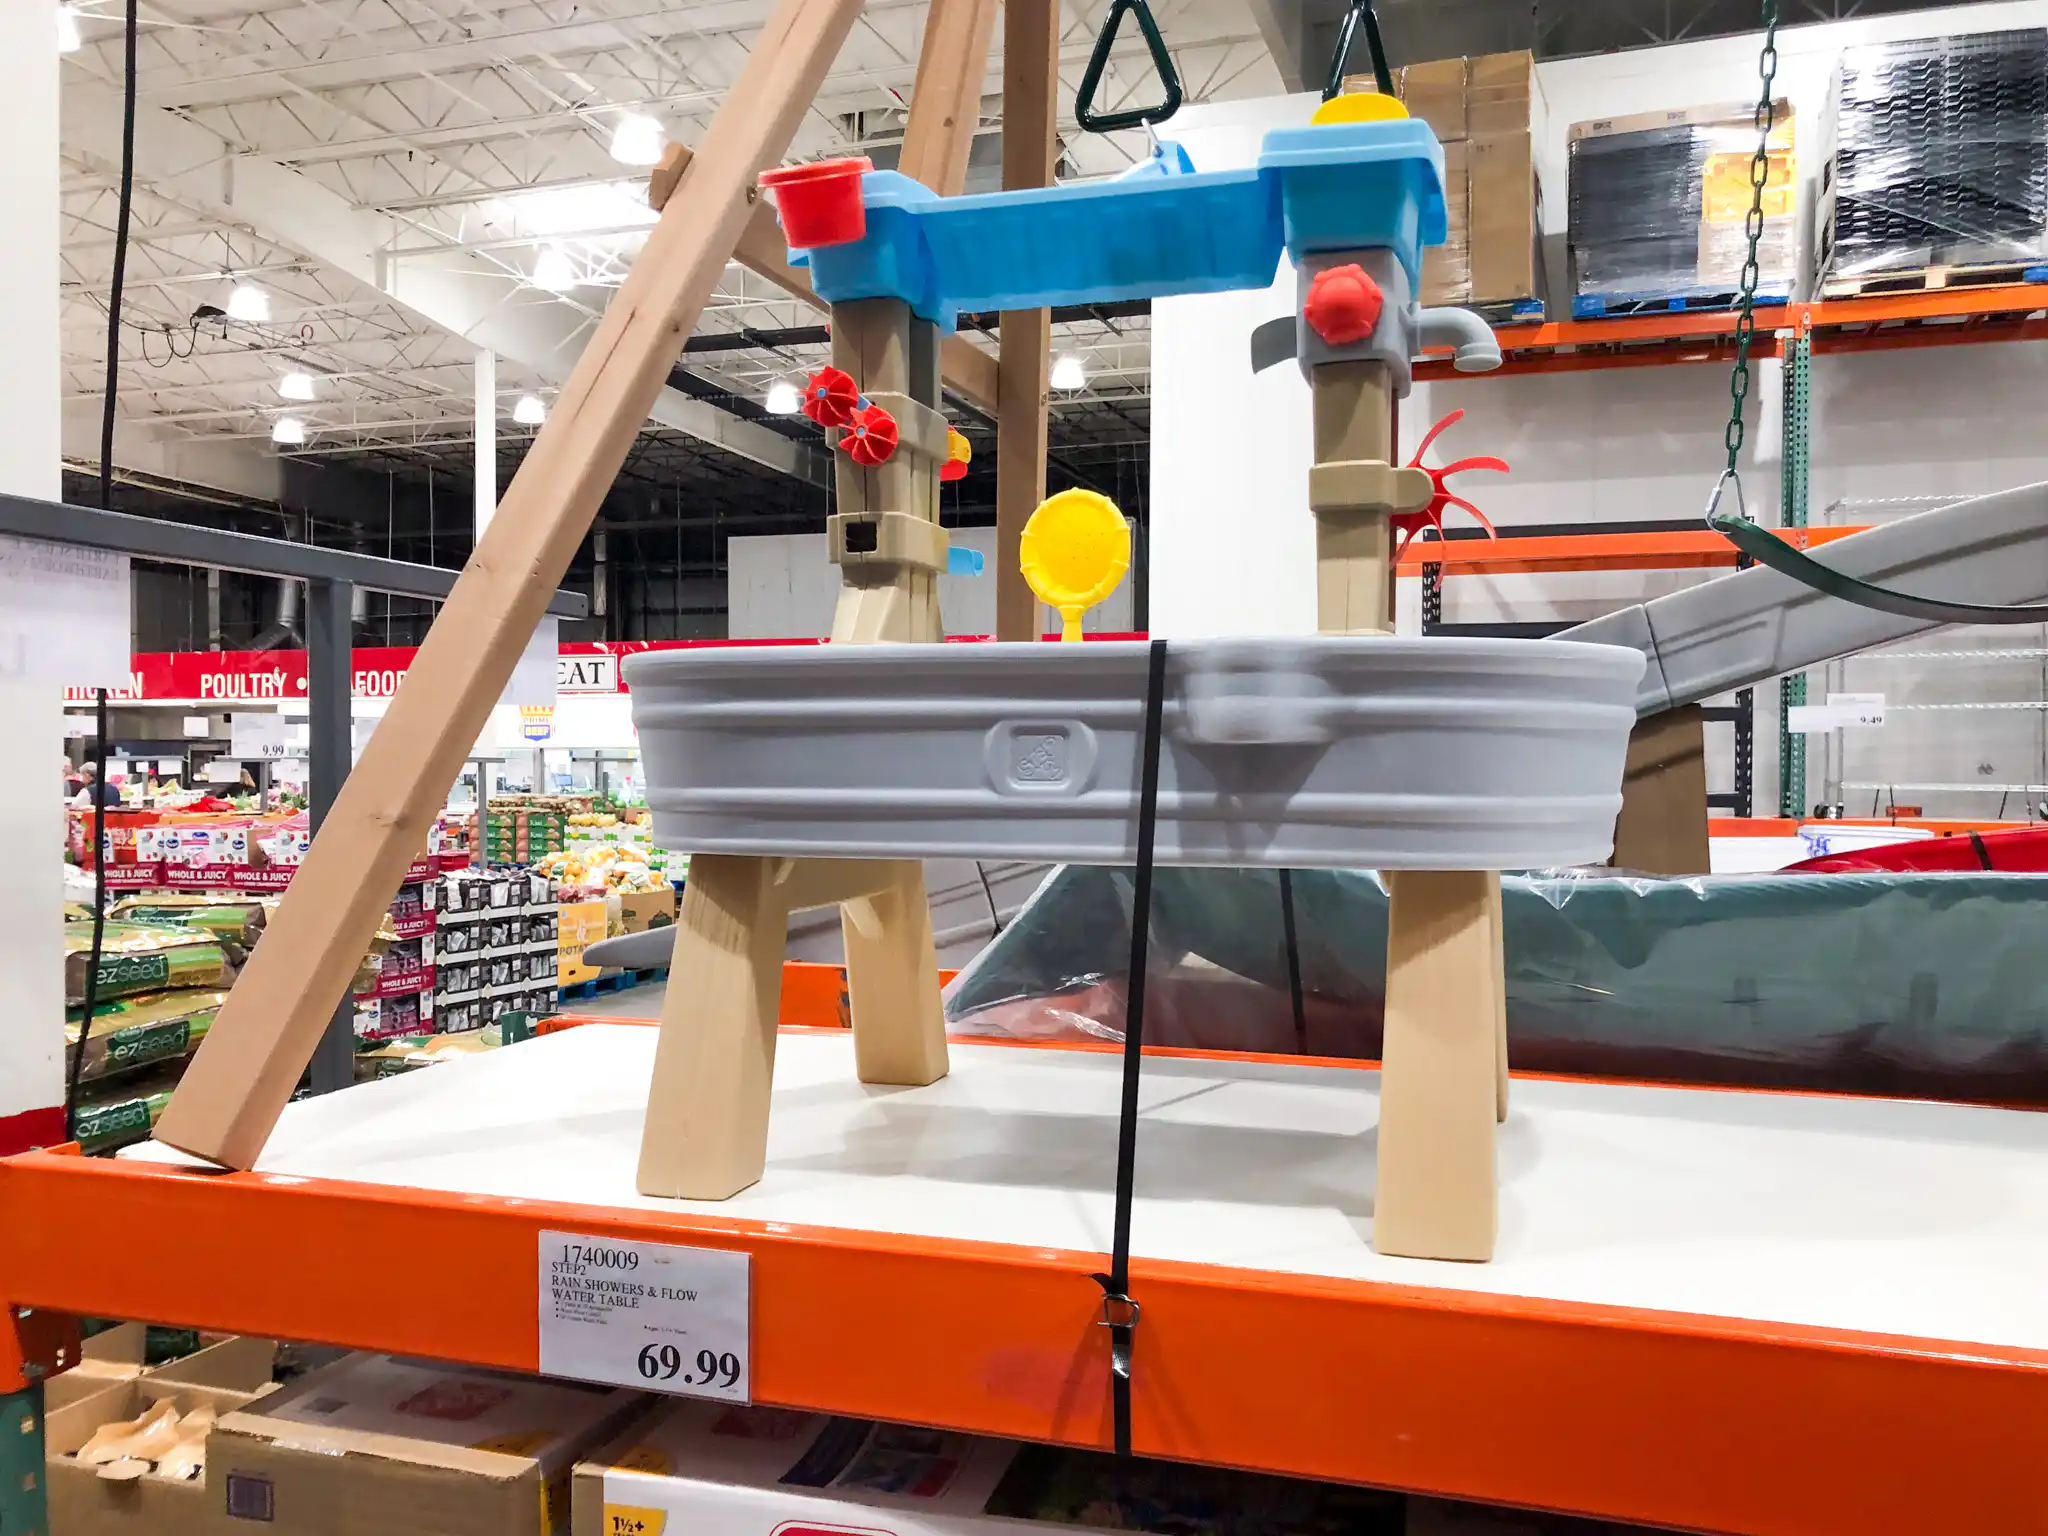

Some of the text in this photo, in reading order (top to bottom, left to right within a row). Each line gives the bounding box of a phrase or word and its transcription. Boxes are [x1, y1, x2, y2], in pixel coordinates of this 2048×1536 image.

[200, 671, 288, 698] POULTRY
[1860, 715, 1883, 725] 9.49
[262, 744, 285, 757] 9.99
[167, 870, 227, 880] WHOLE & JUICY
[233, 871, 292, 882] WHOLE & JUICY
[96, 956, 165, 985] ezseed
[114, 1024, 187, 1060] ezseed
[75, 1102, 146, 1138] ezseed
[551, 1261, 587, 1276] STEP2
[563, 1244, 639, 1271] 1740009
[551, 1275, 698, 1302] RAIN SHOWERS & FLOW
[552, 1288, 596, 1304] WATER
[598, 1293, 640, 1309] TABLE
[638, 1343, 741, 1389] 69.99
